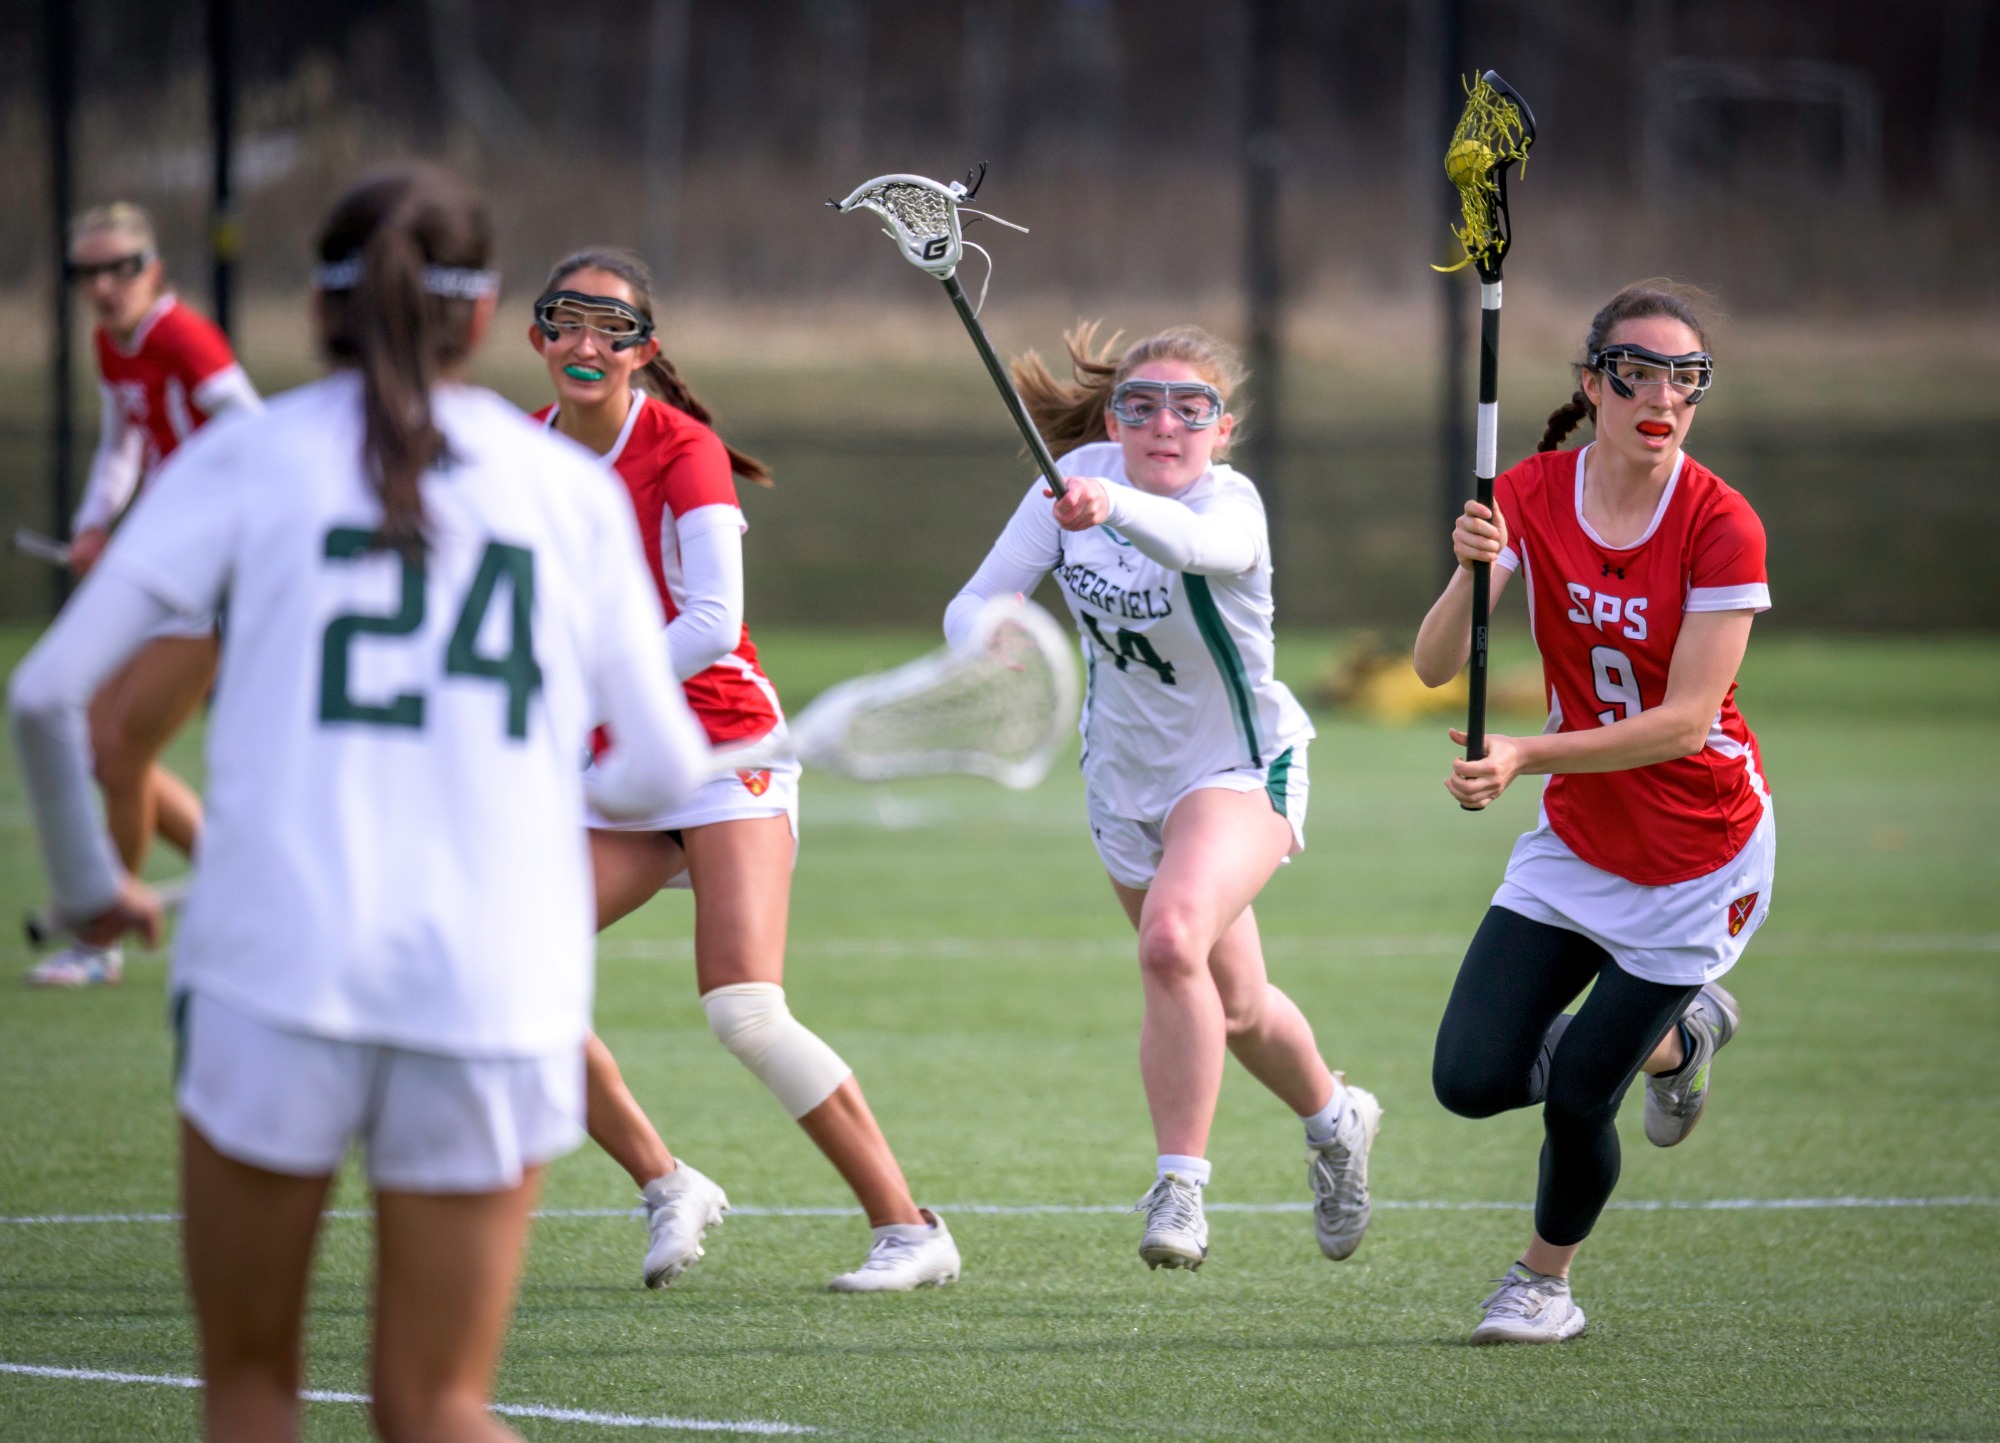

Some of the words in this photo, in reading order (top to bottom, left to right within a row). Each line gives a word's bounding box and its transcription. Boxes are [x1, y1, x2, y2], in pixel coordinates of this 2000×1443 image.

[320, 527, 542, 738] 24
[1080, 609, 1177, 686] 14
[1566, 582, 1648, 640] SPS
[1590, 645, 1643, 727] 9
